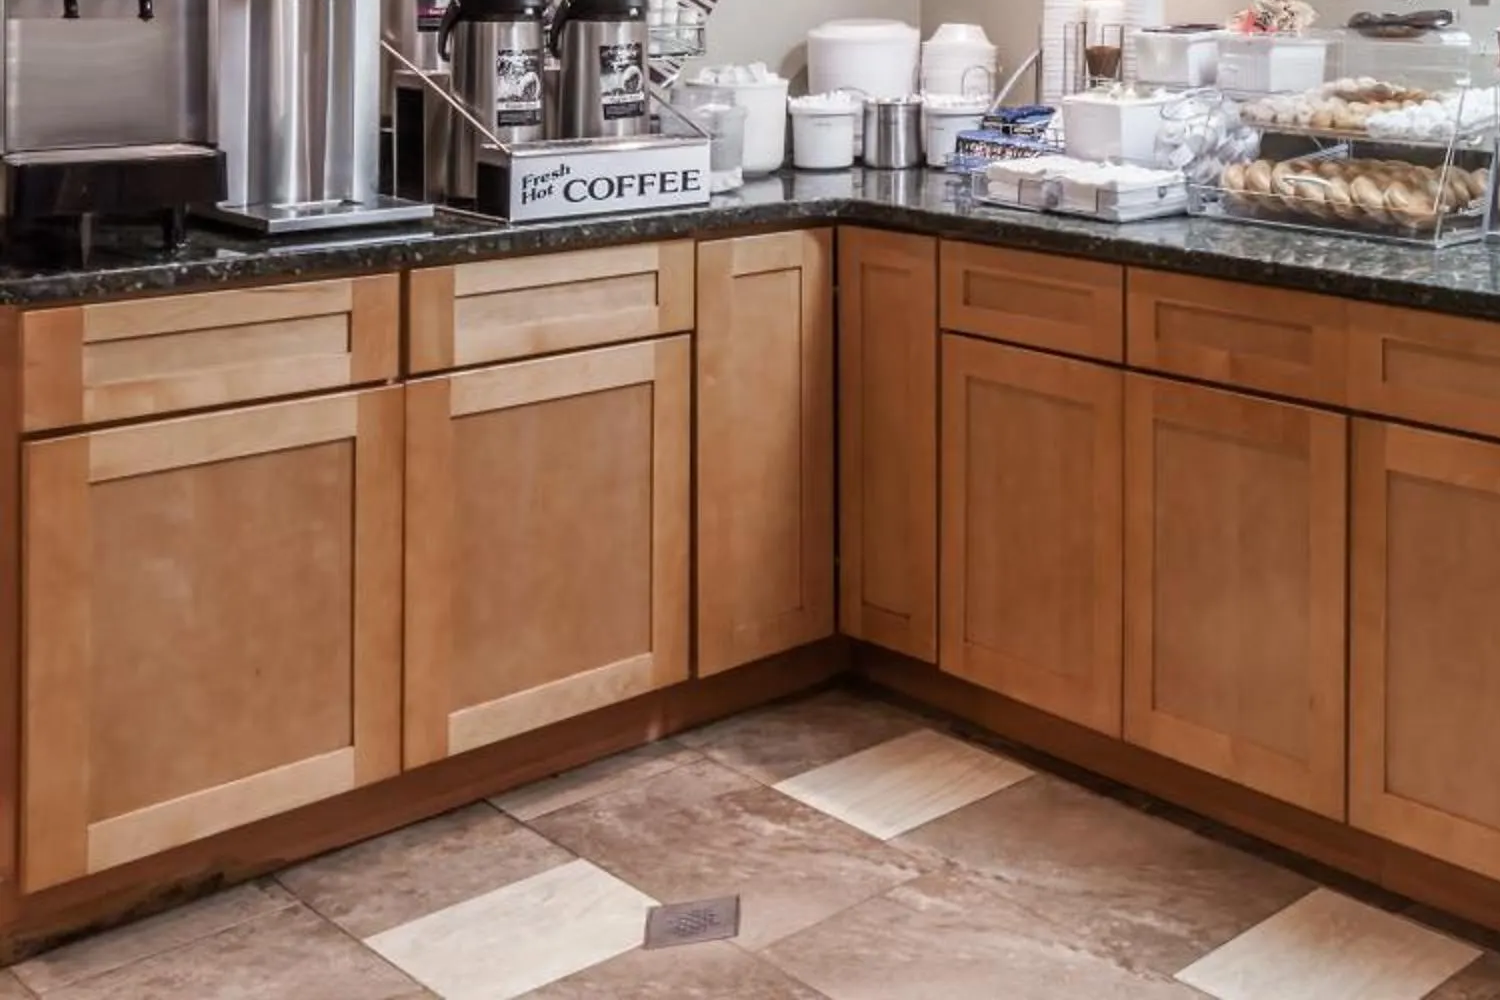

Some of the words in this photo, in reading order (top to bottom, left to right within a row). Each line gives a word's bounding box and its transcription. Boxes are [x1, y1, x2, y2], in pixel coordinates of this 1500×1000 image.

[521, 163, 571, 190] Fresh
[521, 184, 554, 205] Hot
[563, 169, 701, 203] COFFEE
